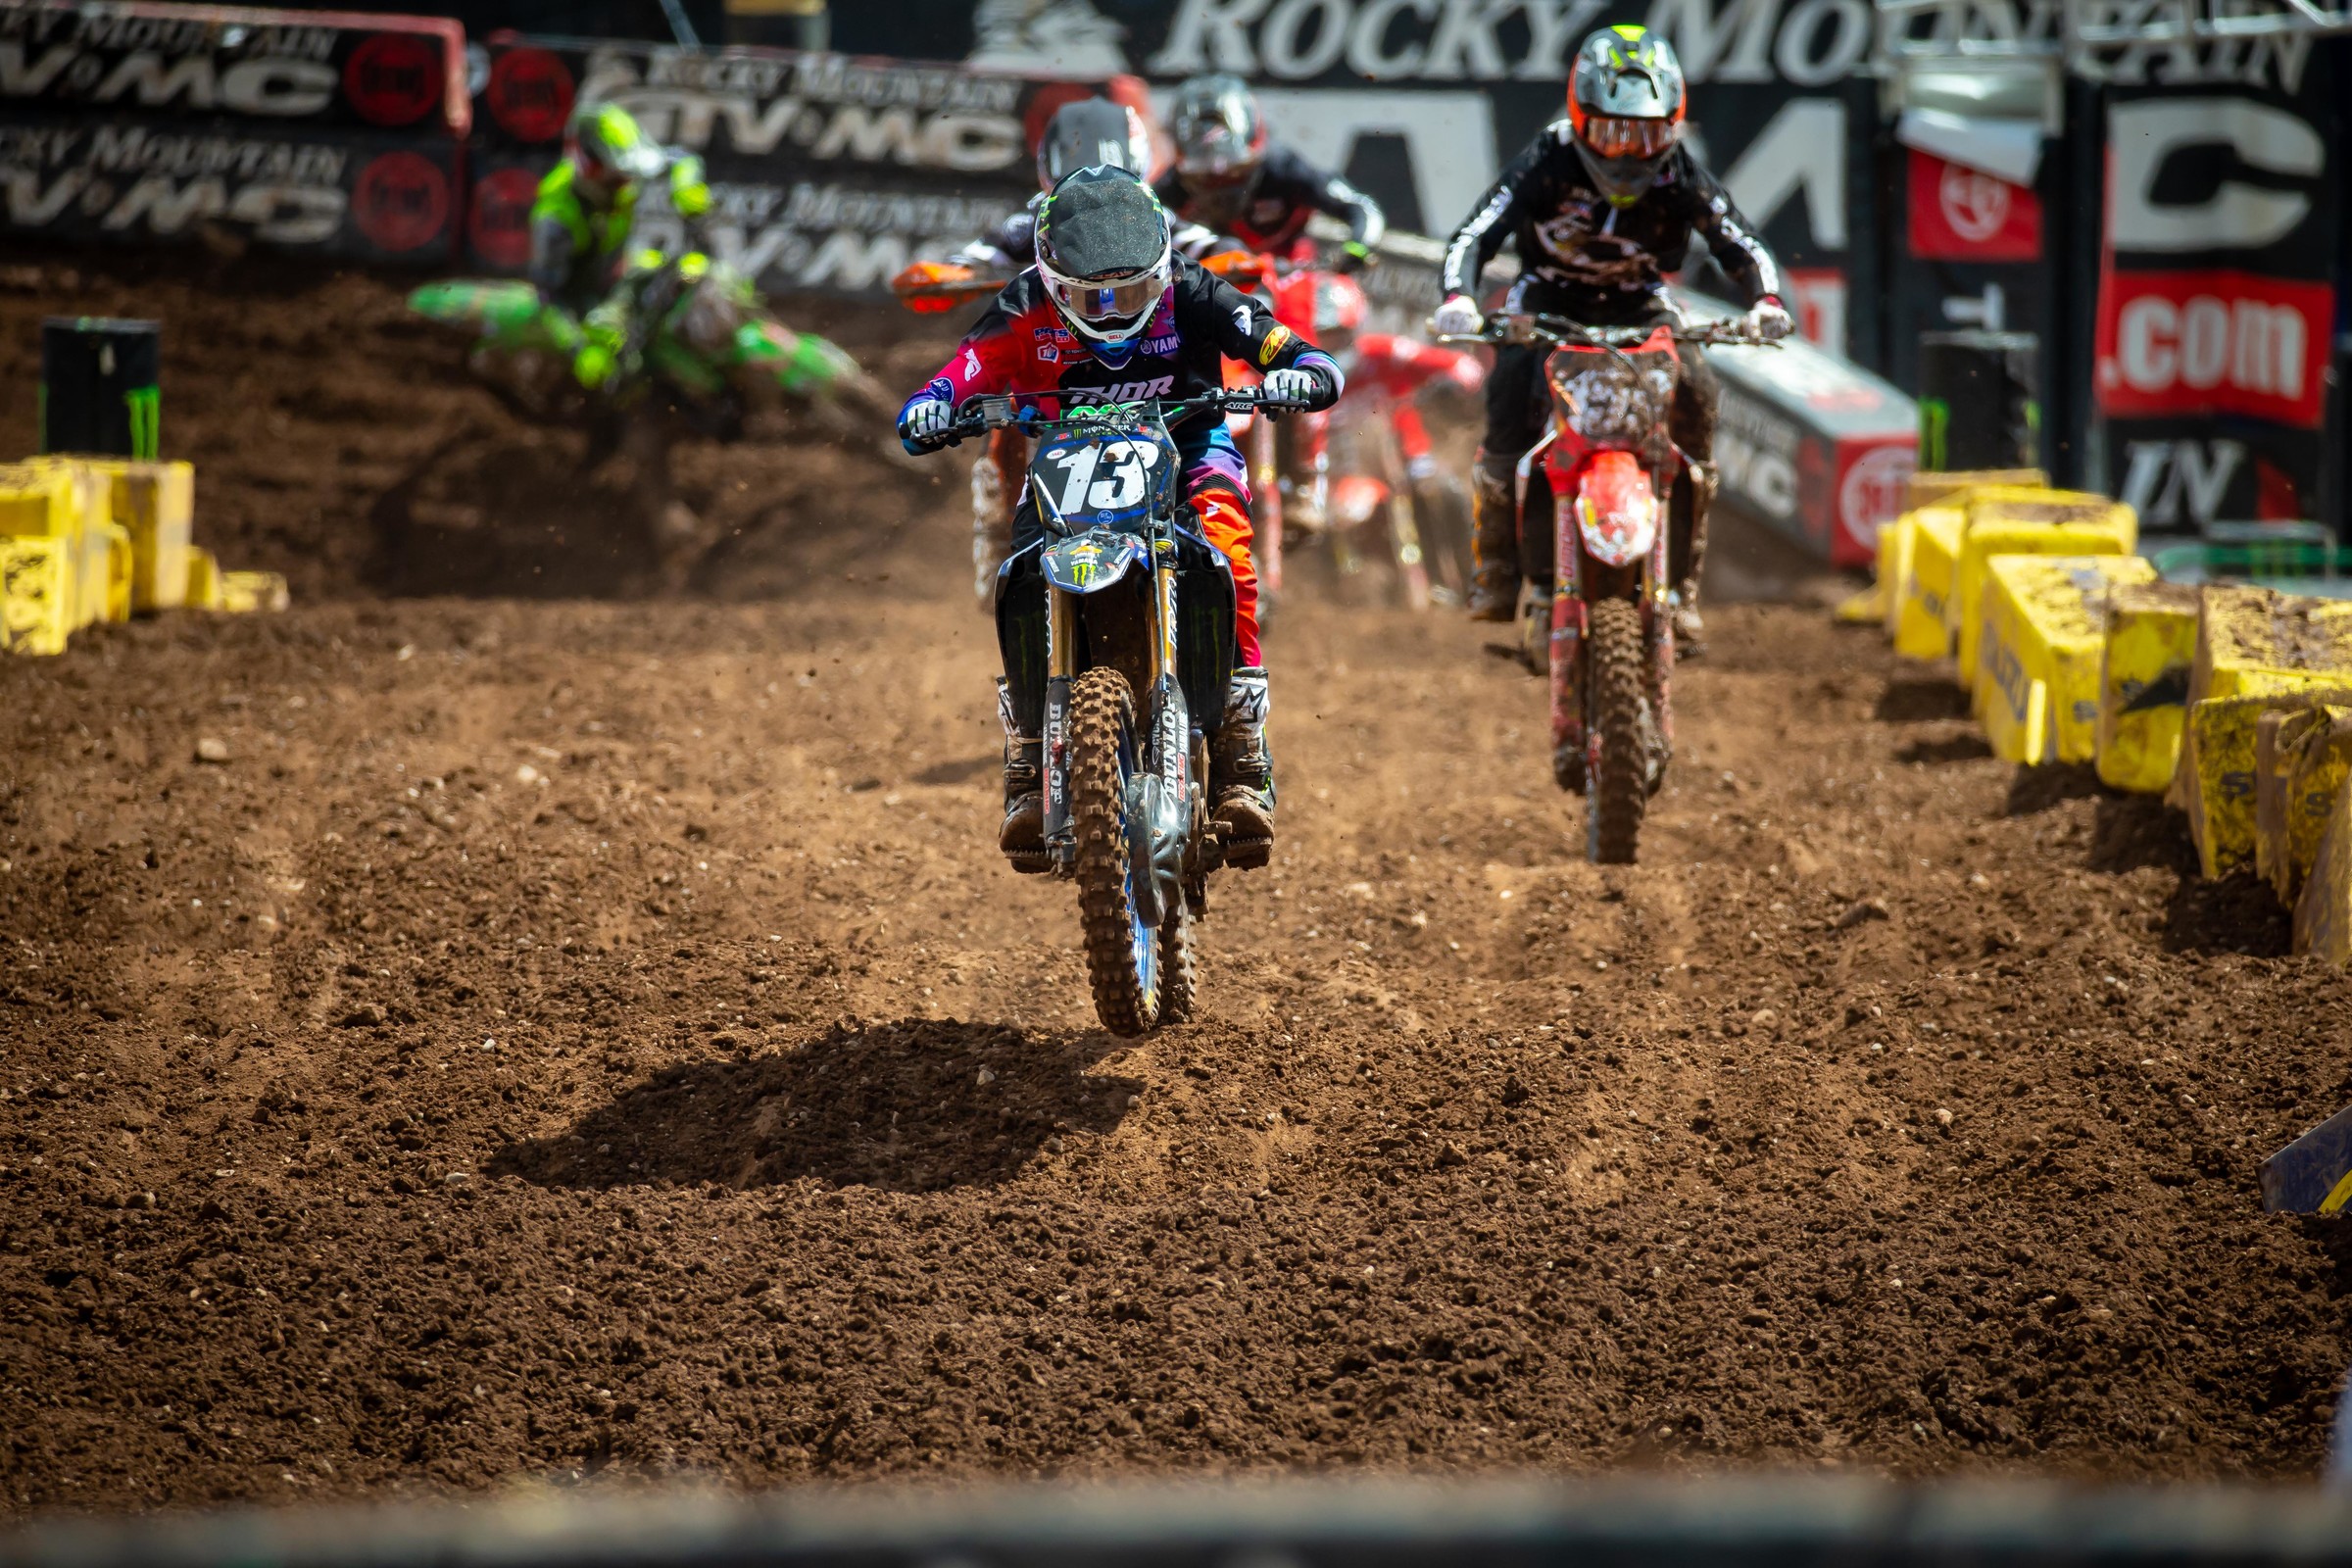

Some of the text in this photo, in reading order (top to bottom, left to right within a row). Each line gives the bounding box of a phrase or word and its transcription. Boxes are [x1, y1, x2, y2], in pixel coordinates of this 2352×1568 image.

[1067, 374, 1175, 405] THOR
[1056, 440, 1159, 515] 13
[1049, 702, 1062, 805] DULOP
